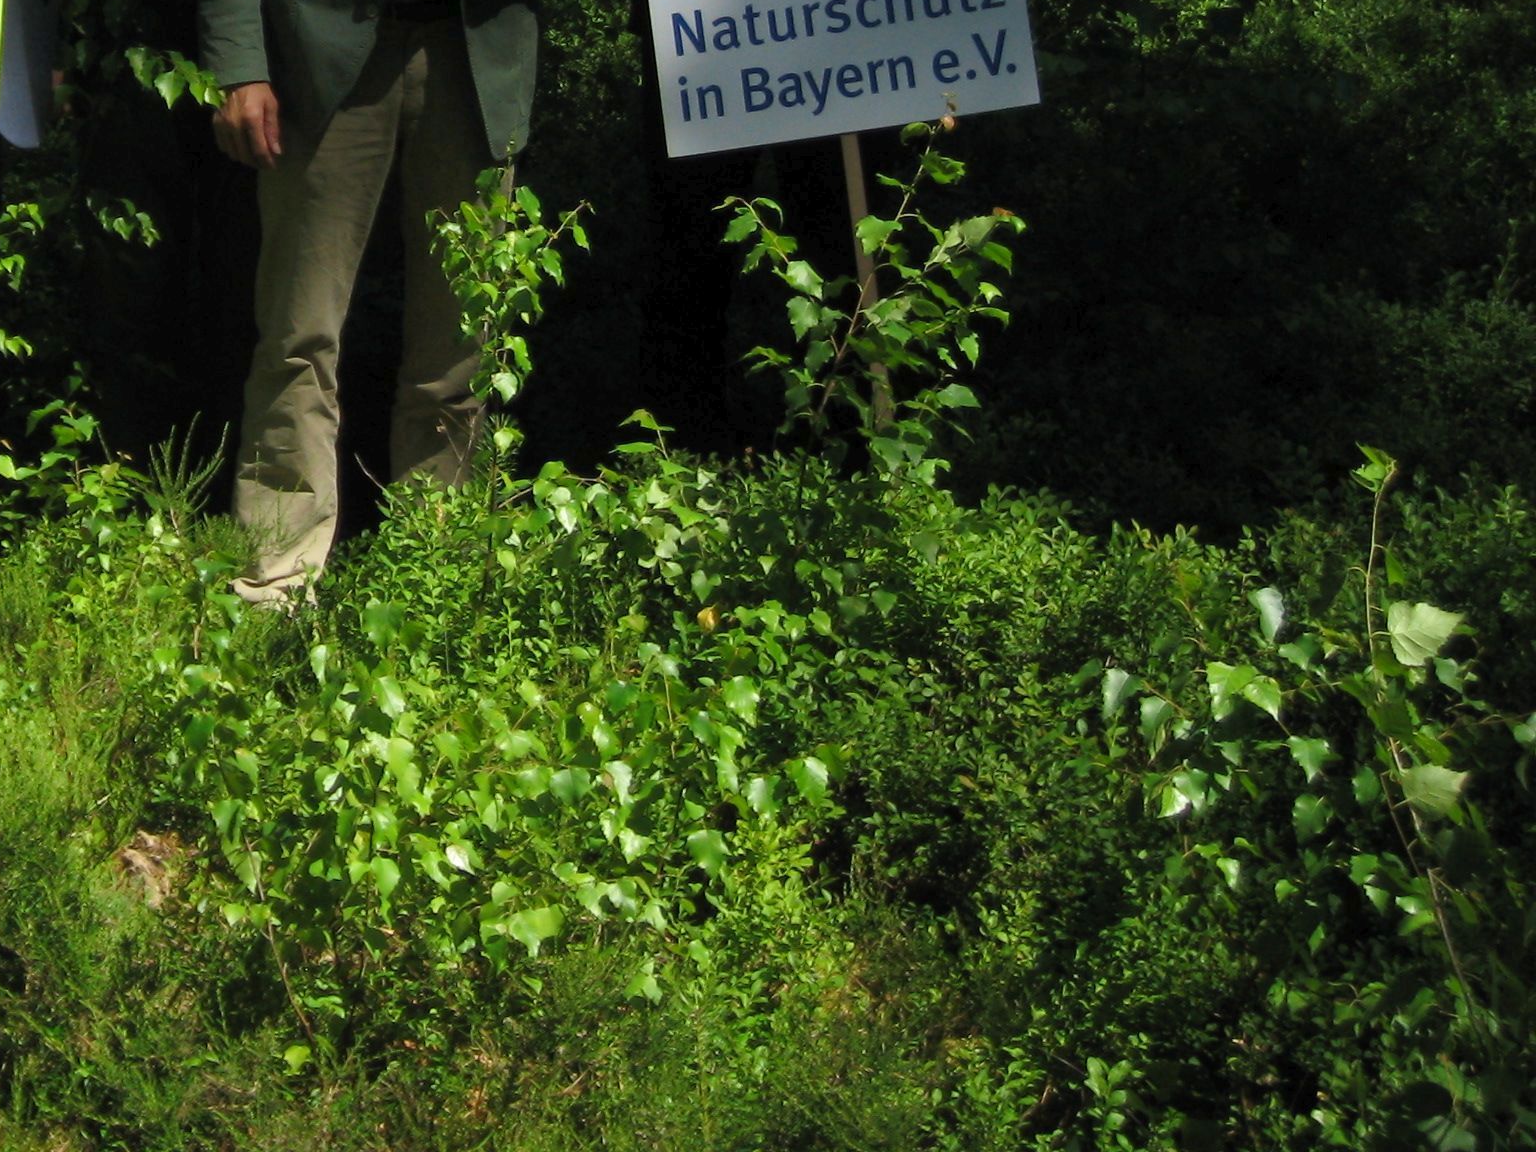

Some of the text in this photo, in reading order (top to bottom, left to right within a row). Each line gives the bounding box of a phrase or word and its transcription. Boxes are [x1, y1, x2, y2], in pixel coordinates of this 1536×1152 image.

[678, 28, 1018, 123] in Bayern e.V.
